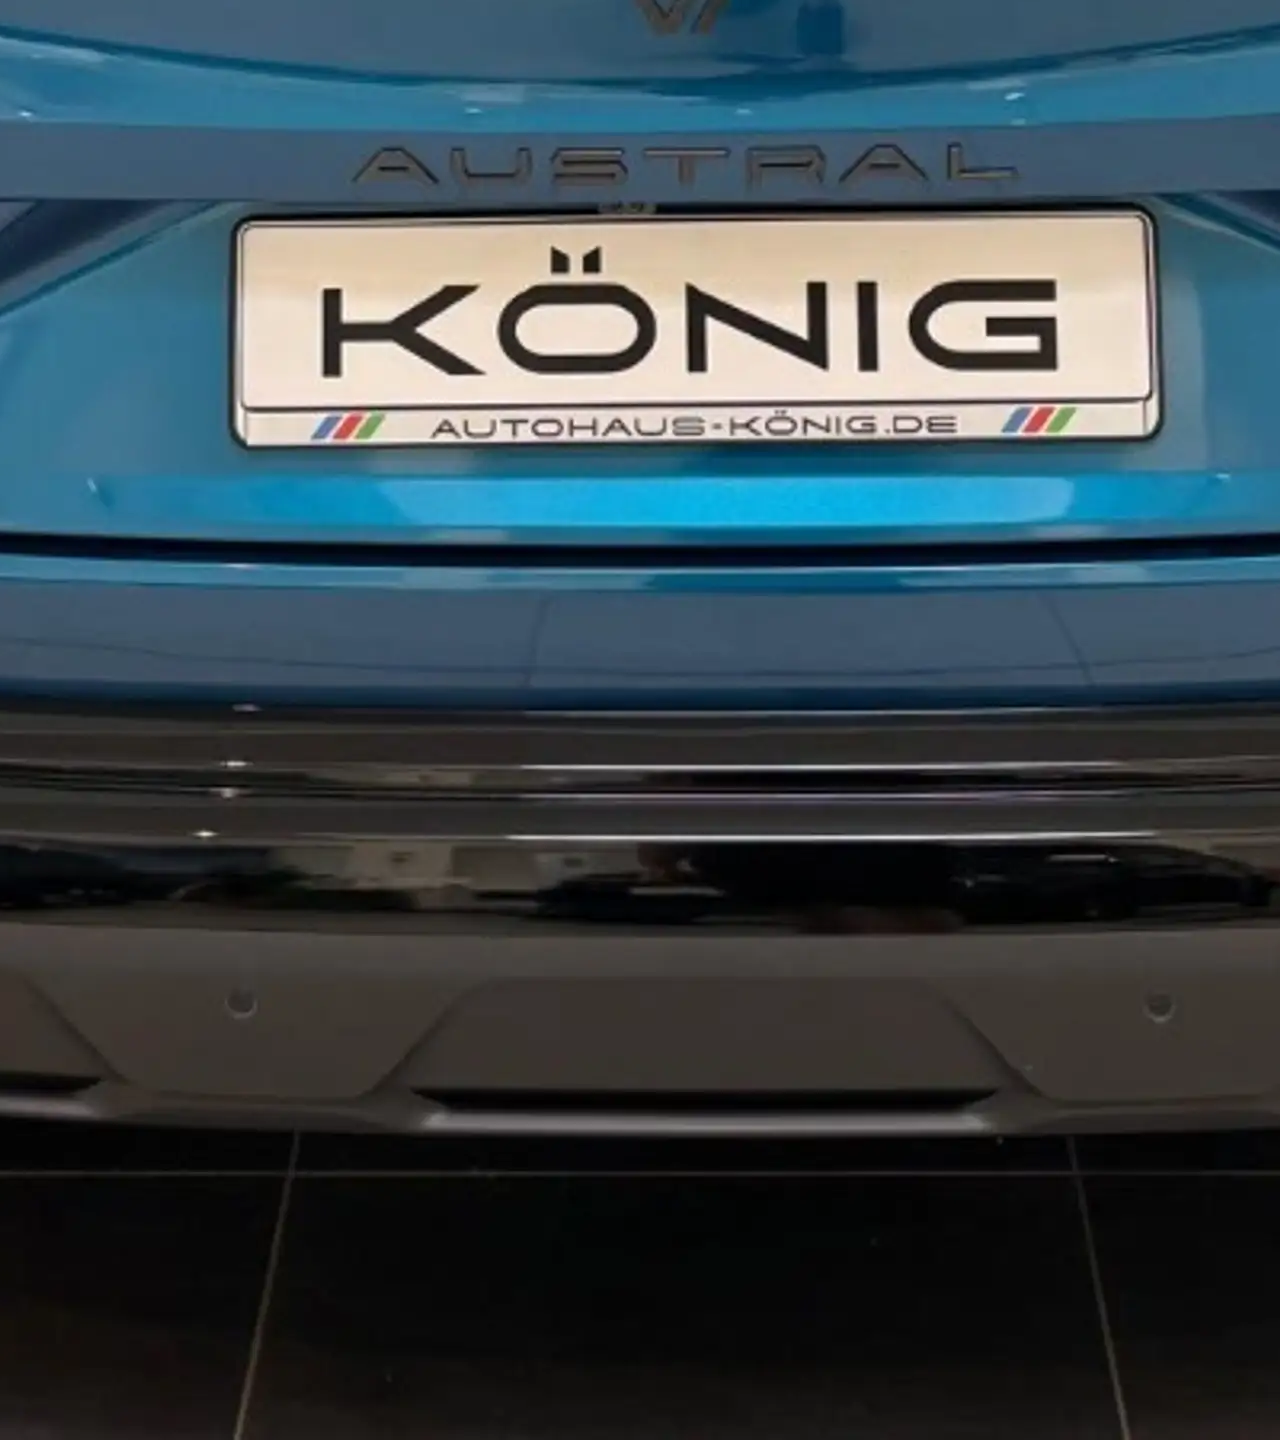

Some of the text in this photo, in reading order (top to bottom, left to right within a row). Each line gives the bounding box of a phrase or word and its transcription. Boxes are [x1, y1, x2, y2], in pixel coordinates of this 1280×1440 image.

[350, 142, 1019, 190] AUSTRAL
[322, 245, 1058, 378] KÖNIG
[429, 409, 958, 441] AUTOHAUS-KÖNIG.DE
